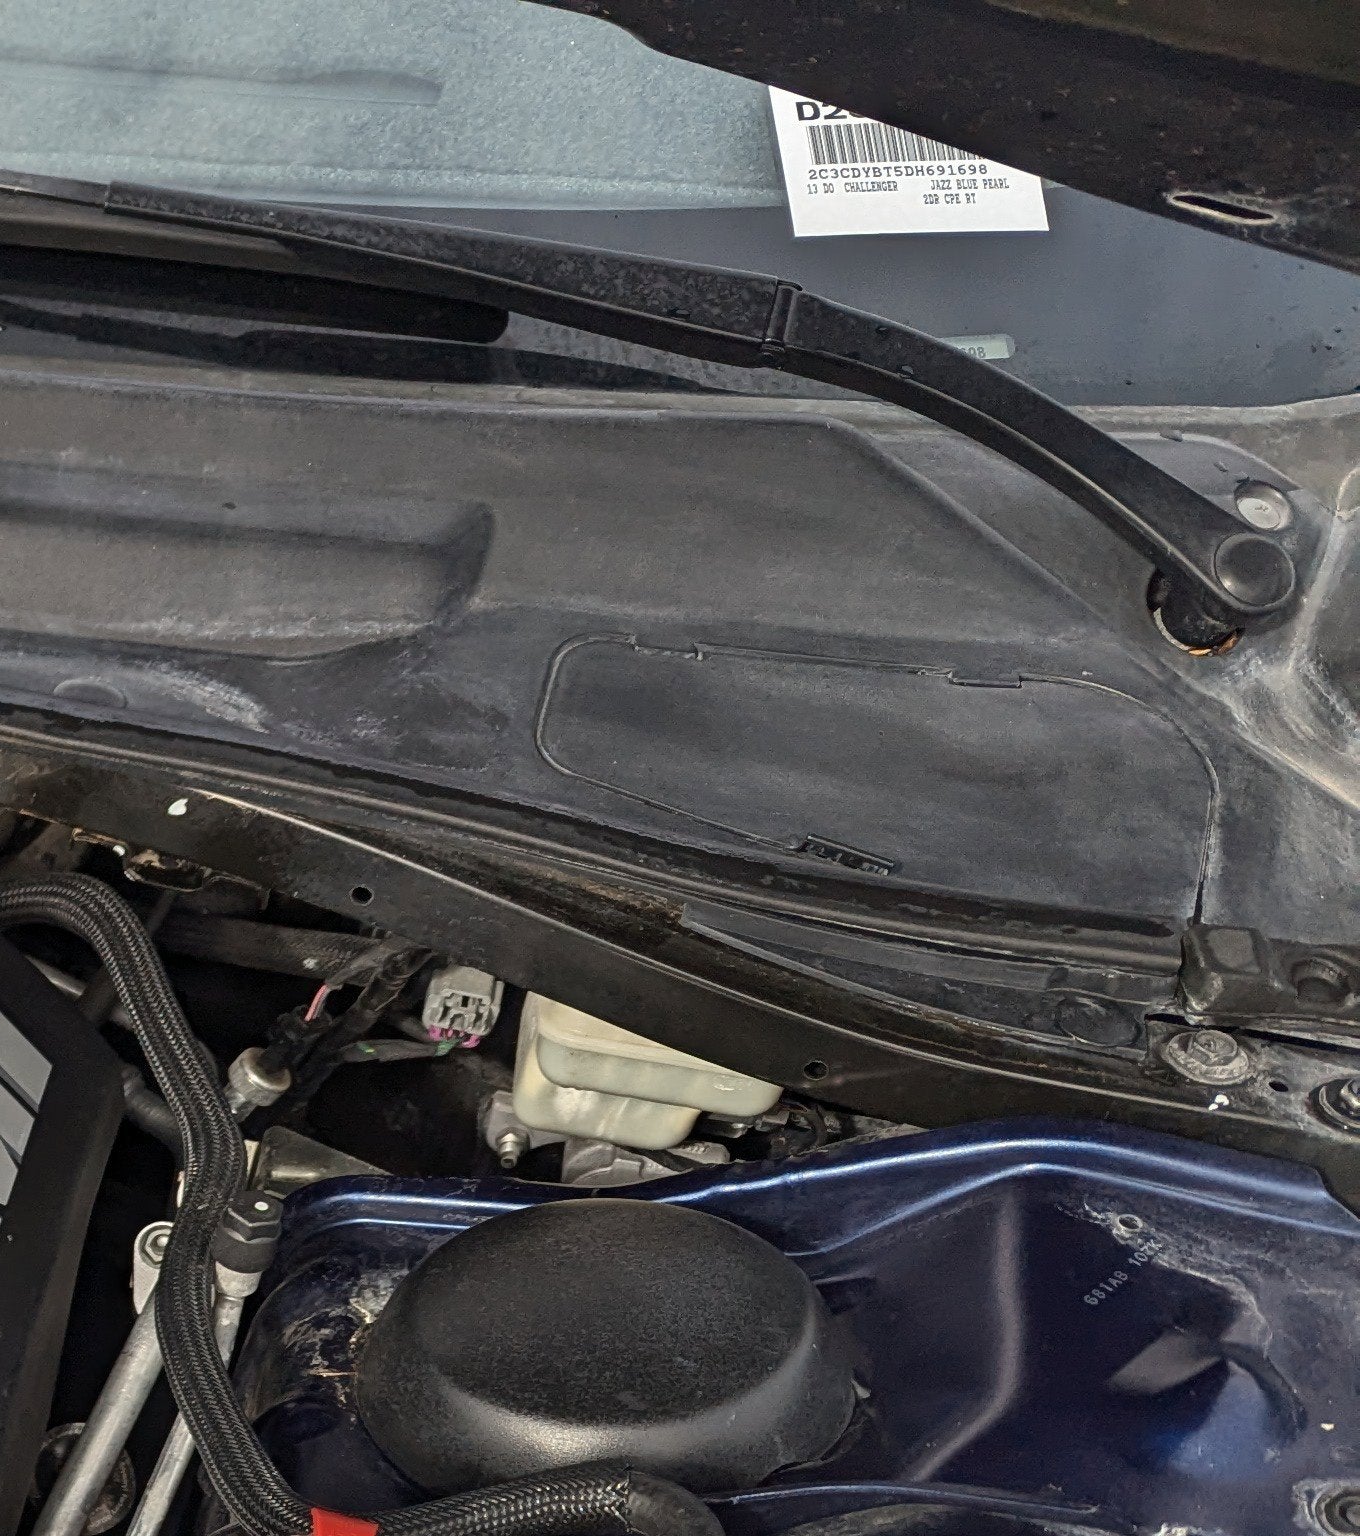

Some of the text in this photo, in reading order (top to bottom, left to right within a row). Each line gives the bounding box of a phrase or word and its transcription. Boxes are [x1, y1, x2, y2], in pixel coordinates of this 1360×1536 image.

[795, 101, 865, 121] D2
[808, 164, 988, 180] 2C3CDYBT5DH691698
[807, 183, 819, 194] 13
[844, 181, 899, 194] CHALLENGER
[930, 177, 1010, 190] JAZZ BLUE PEARL
[923, 194, 940, 204] 2DR
[944, 194, 961, 204] CPE
